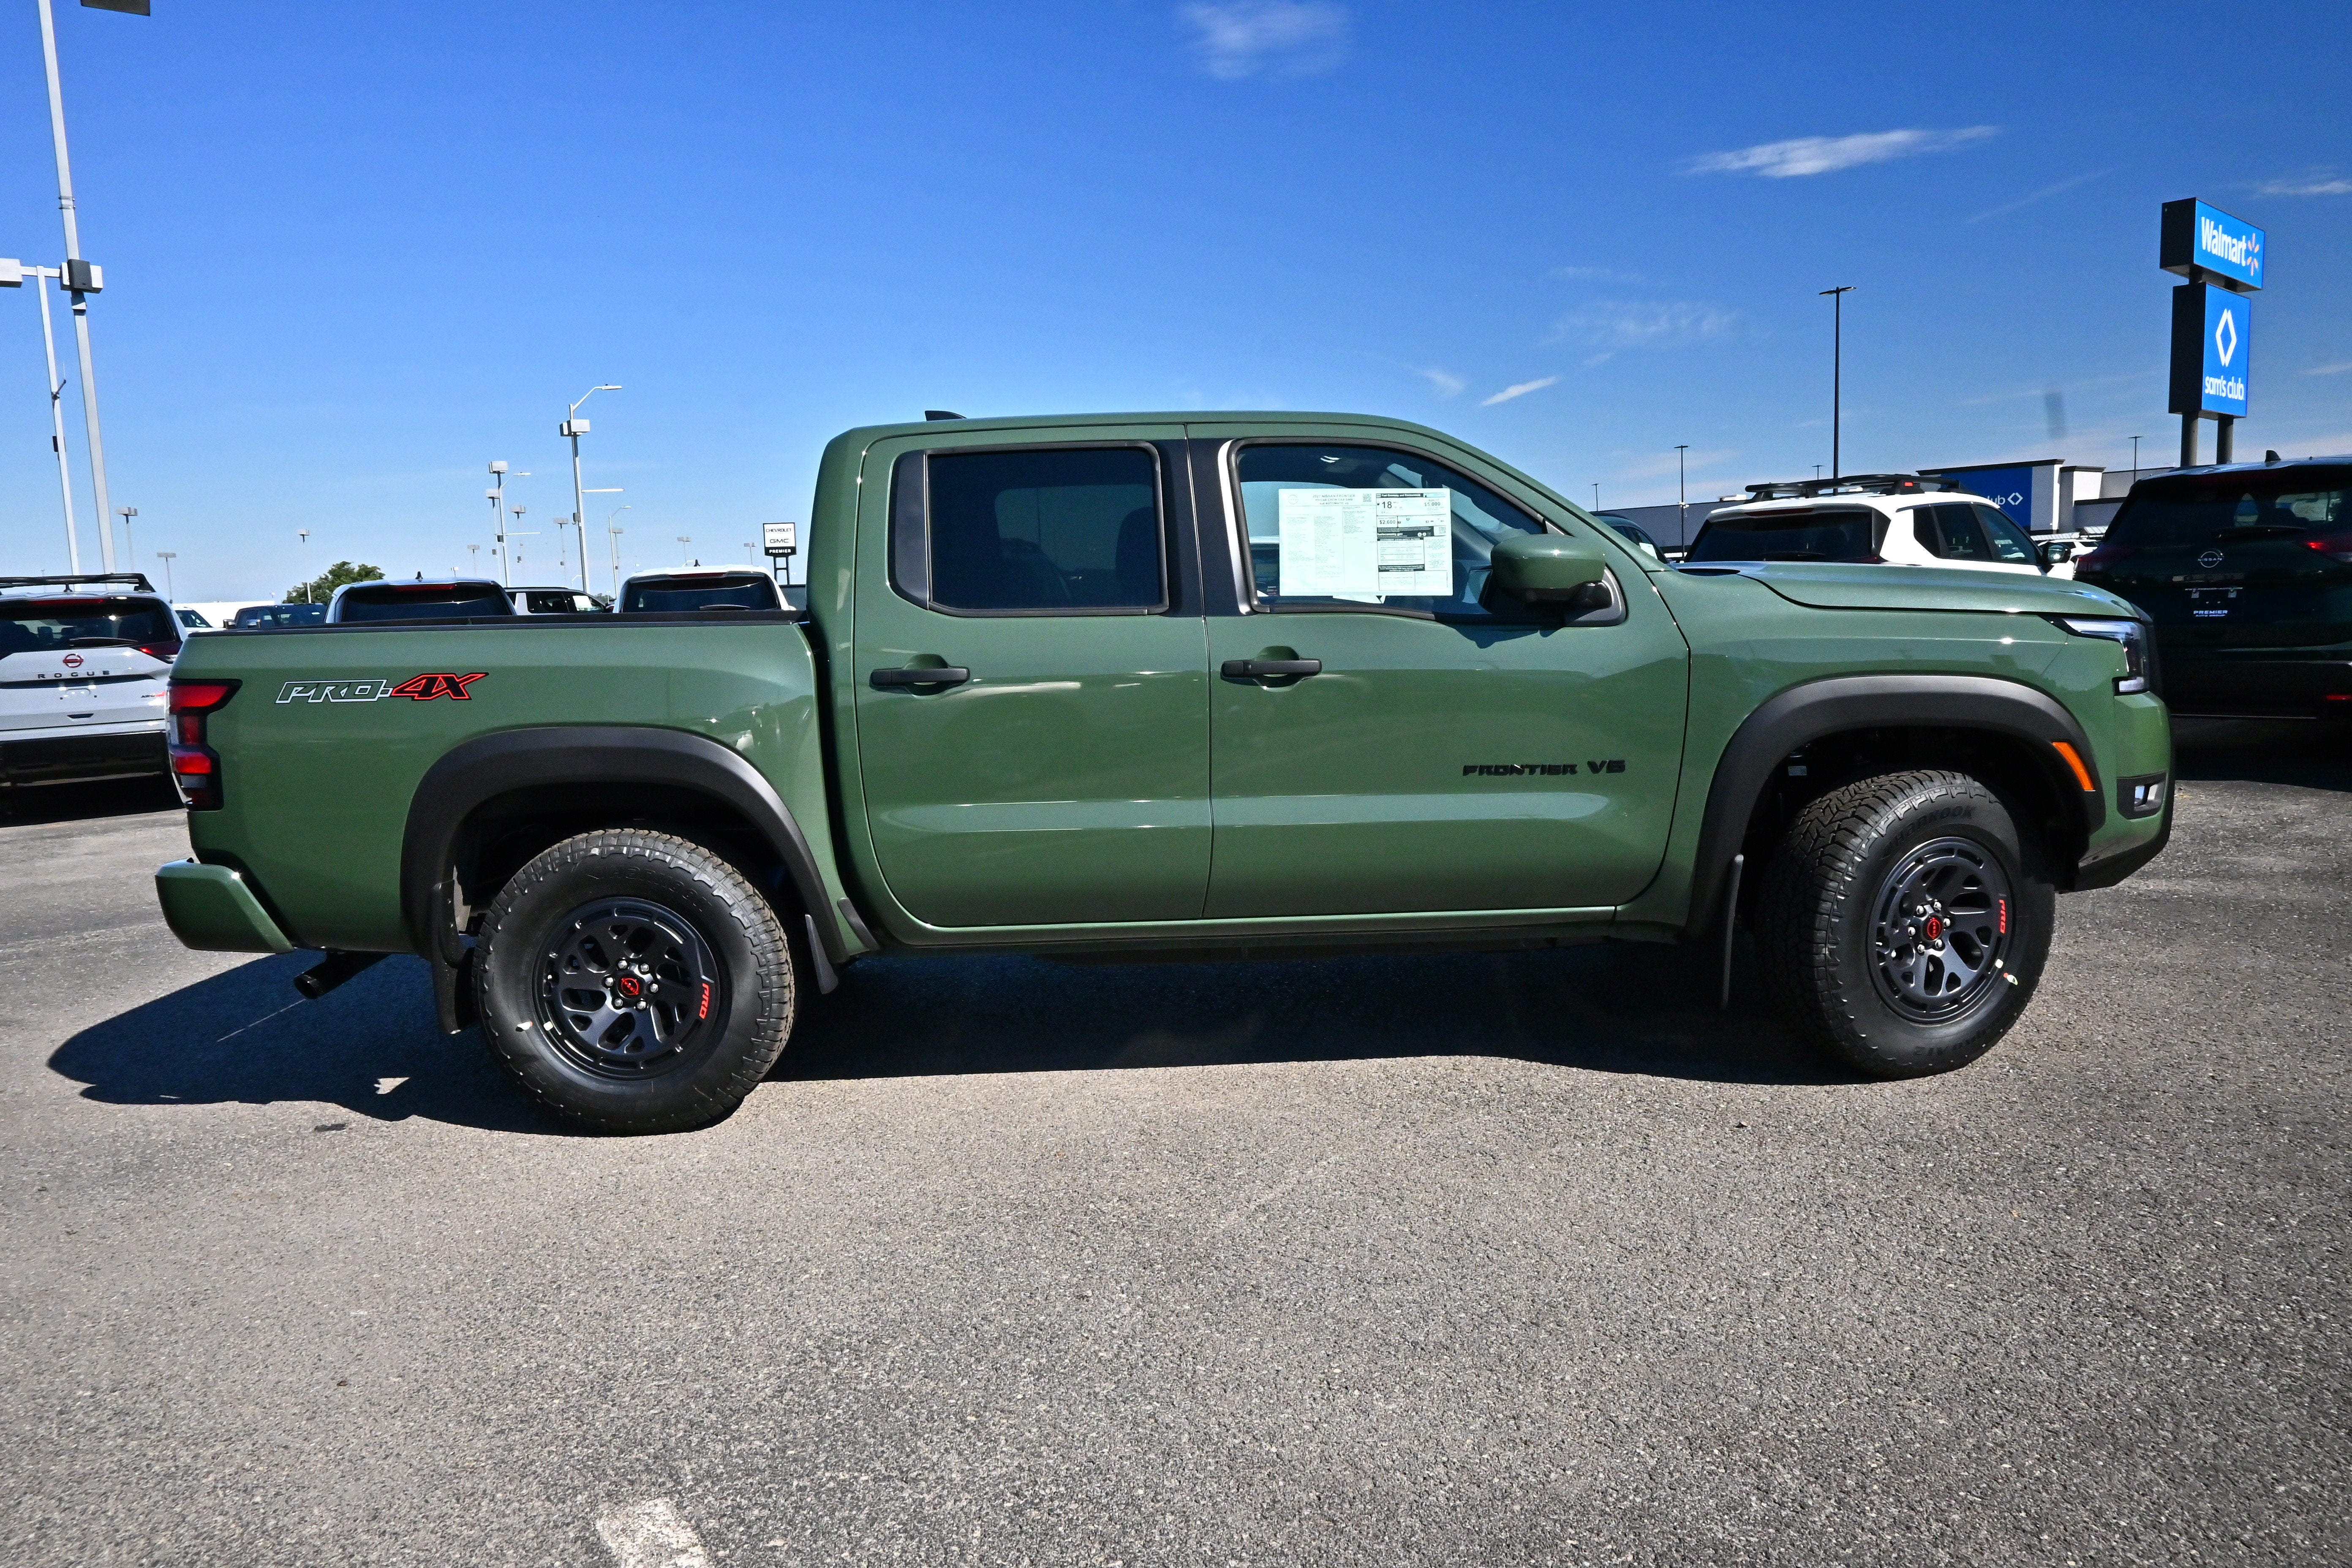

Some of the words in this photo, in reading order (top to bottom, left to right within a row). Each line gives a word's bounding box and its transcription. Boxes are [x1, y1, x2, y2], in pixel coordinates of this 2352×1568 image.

[2201, 216, 2247, 267] Walmart
[2205, 375, 2226, 397] sam's
[2227, 376, 2244, 401] club
[37, 670, 110, 679] ROGUE
[1462, 764, 1578, 776] FRONTIER
[1587, 759, 1626, 774] V6
[1998, 899, 2007, 934] PRO
[698, 983, 711, 1020] PRO
